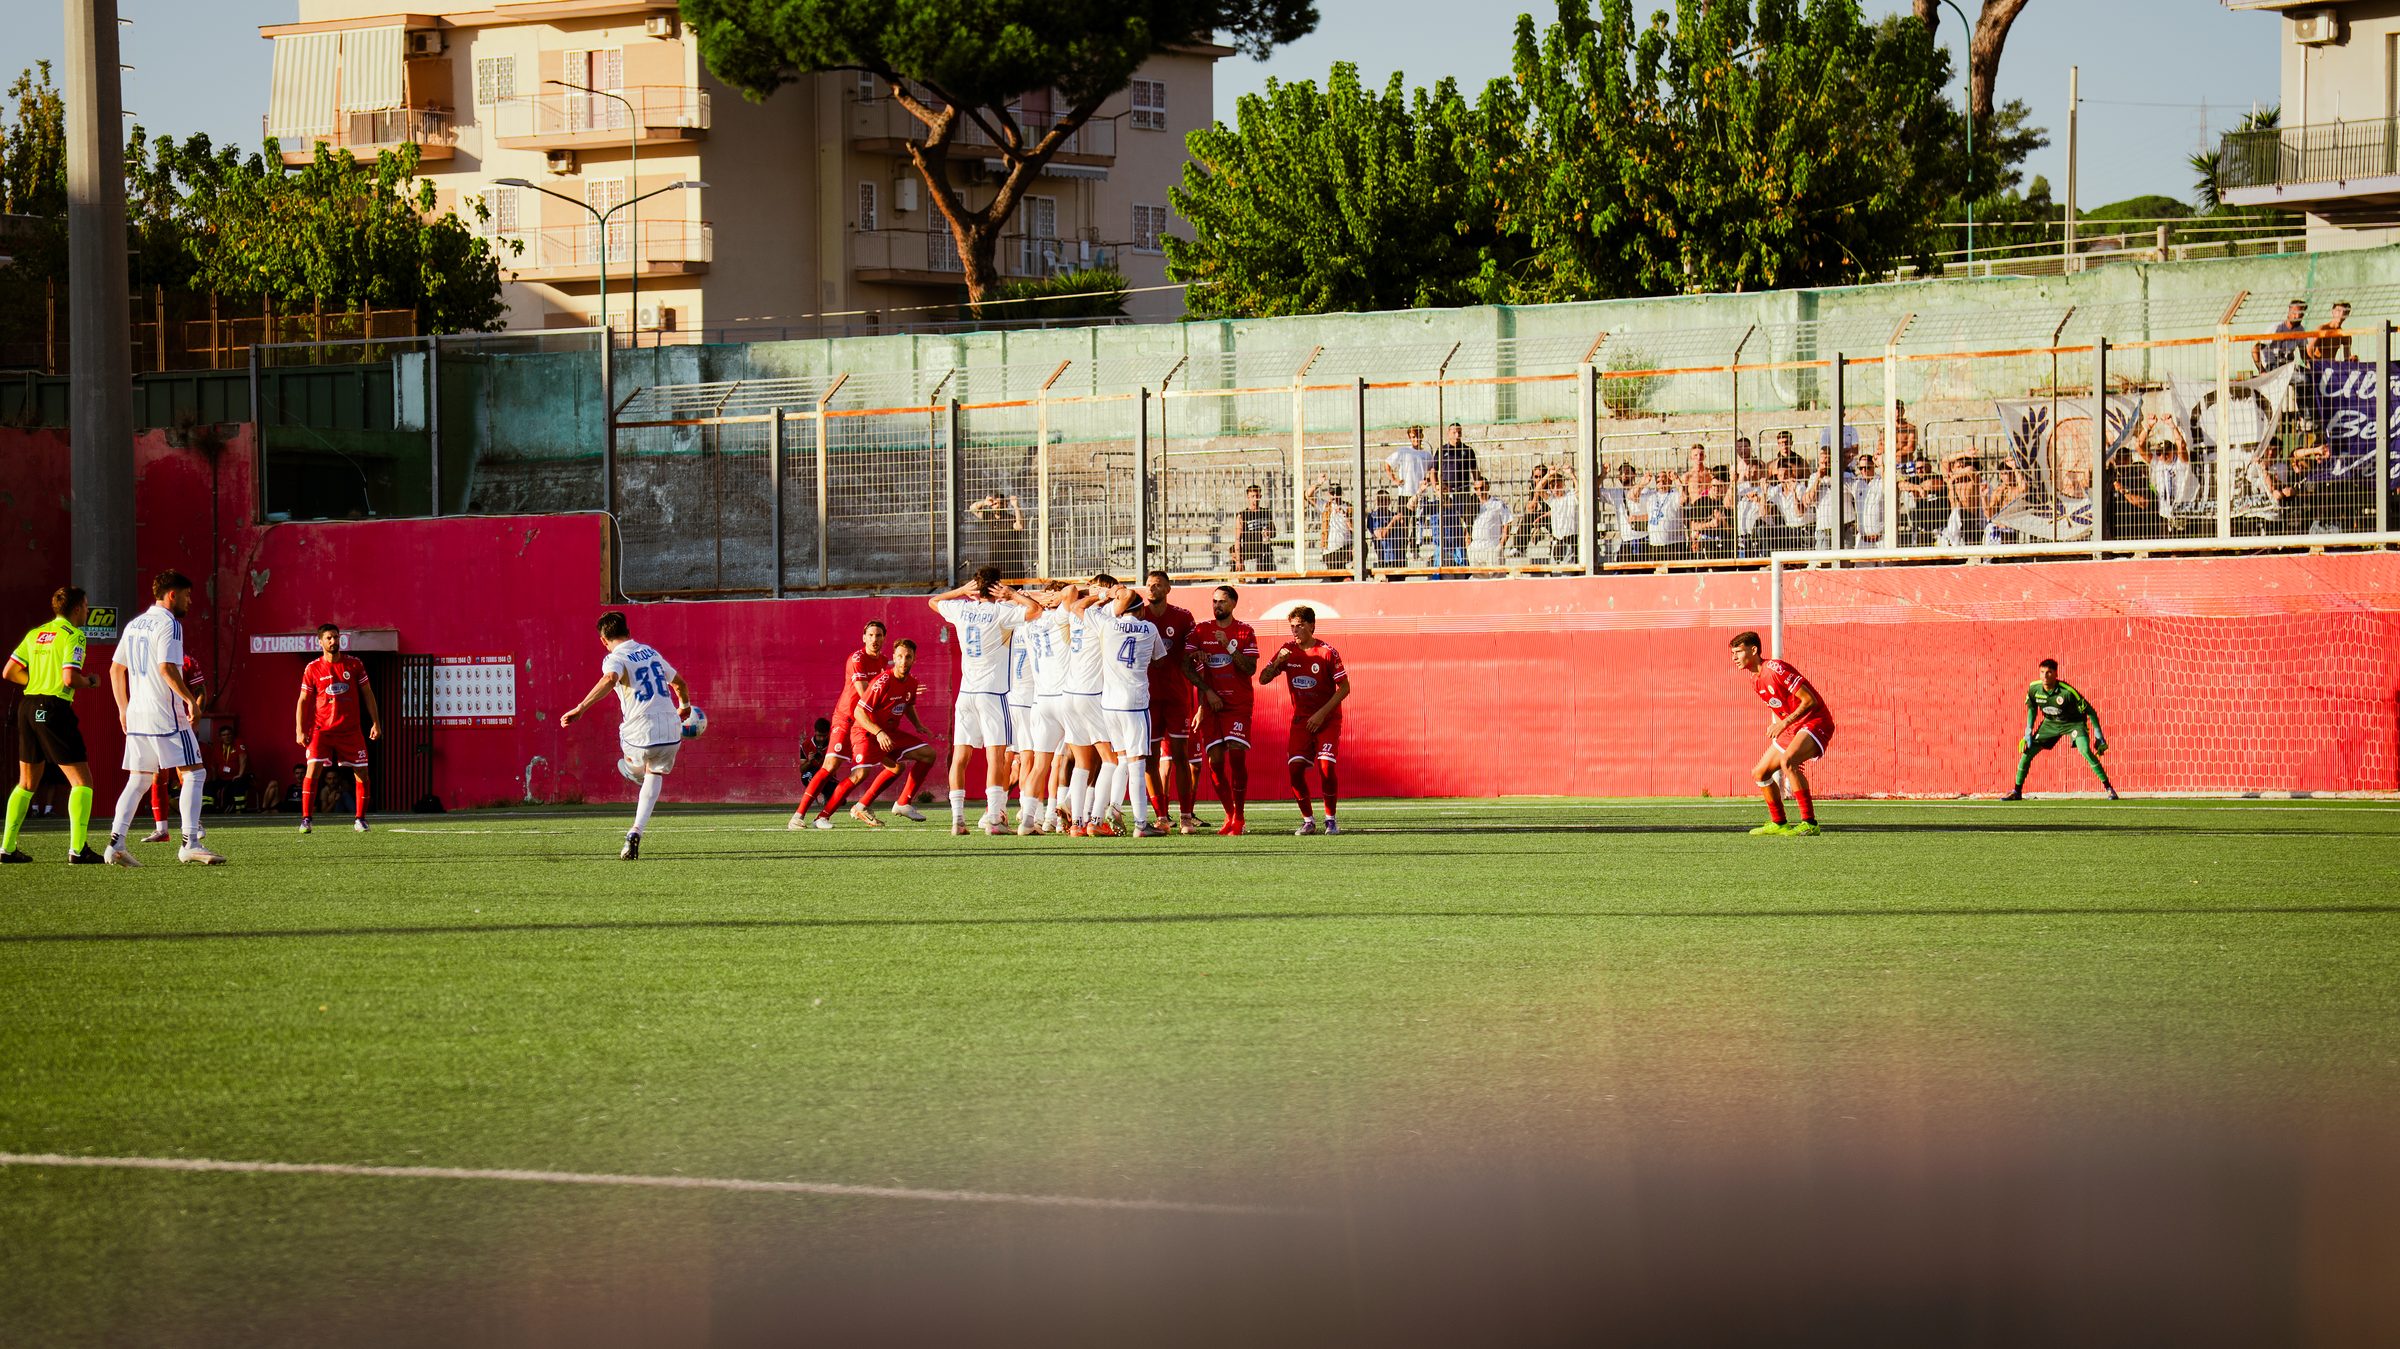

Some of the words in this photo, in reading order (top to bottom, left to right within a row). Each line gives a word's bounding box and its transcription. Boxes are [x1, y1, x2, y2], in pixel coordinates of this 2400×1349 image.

[87, 608, 116, 627] Gò
[264, 636, 306, 651] TURRIS
[966, 625, 982, 658] 9
[1117, 636, 1136, 669] 4
[129, 636, 149, 676] 10
[1014, 648, 1027, 679] 7
[1233, 721, 1244, 731] 20
[1322, 743, 1333, 752] 27
